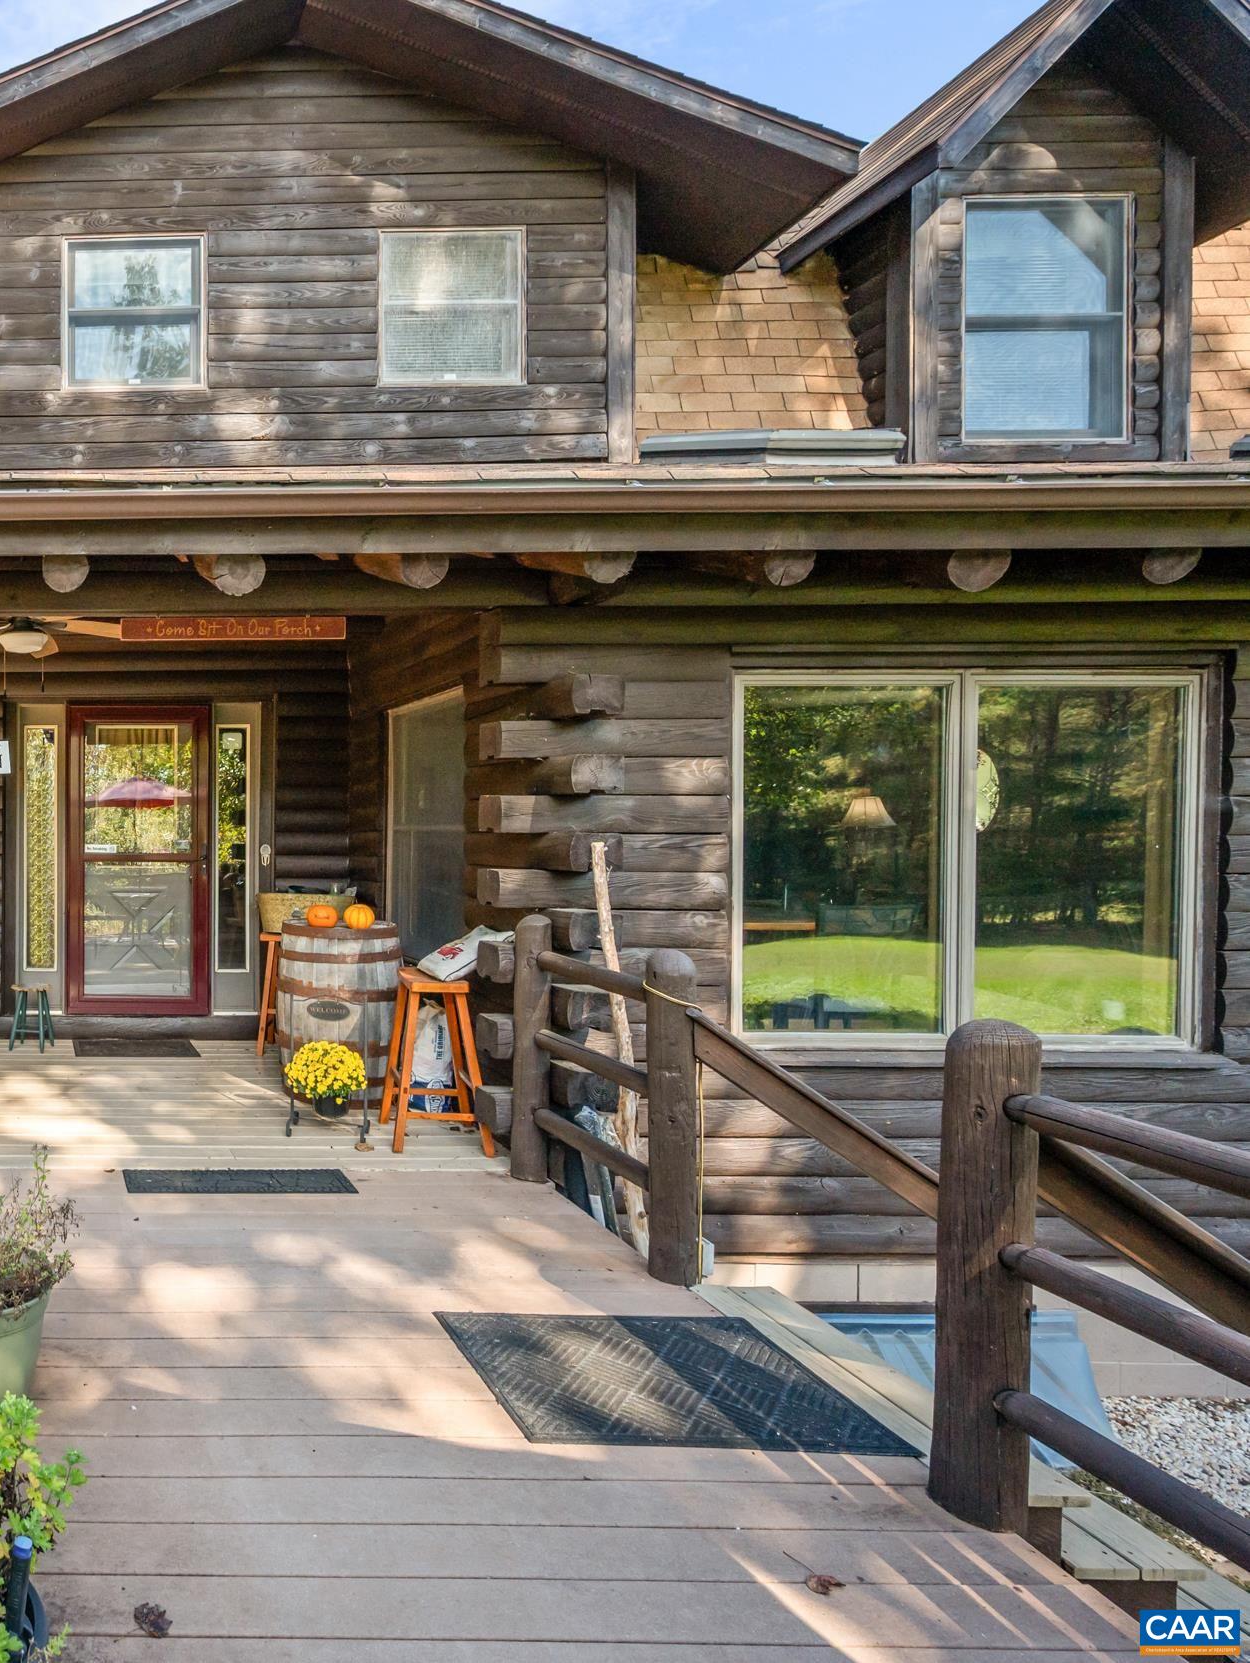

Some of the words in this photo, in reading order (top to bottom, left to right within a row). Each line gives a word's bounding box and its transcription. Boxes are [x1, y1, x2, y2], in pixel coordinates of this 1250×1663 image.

[156, 619, 194, 637] Come
[226, 620, 244, 635] On
[248, 620, 271, 635] Our
[275, 619, 312, 637] Porch
